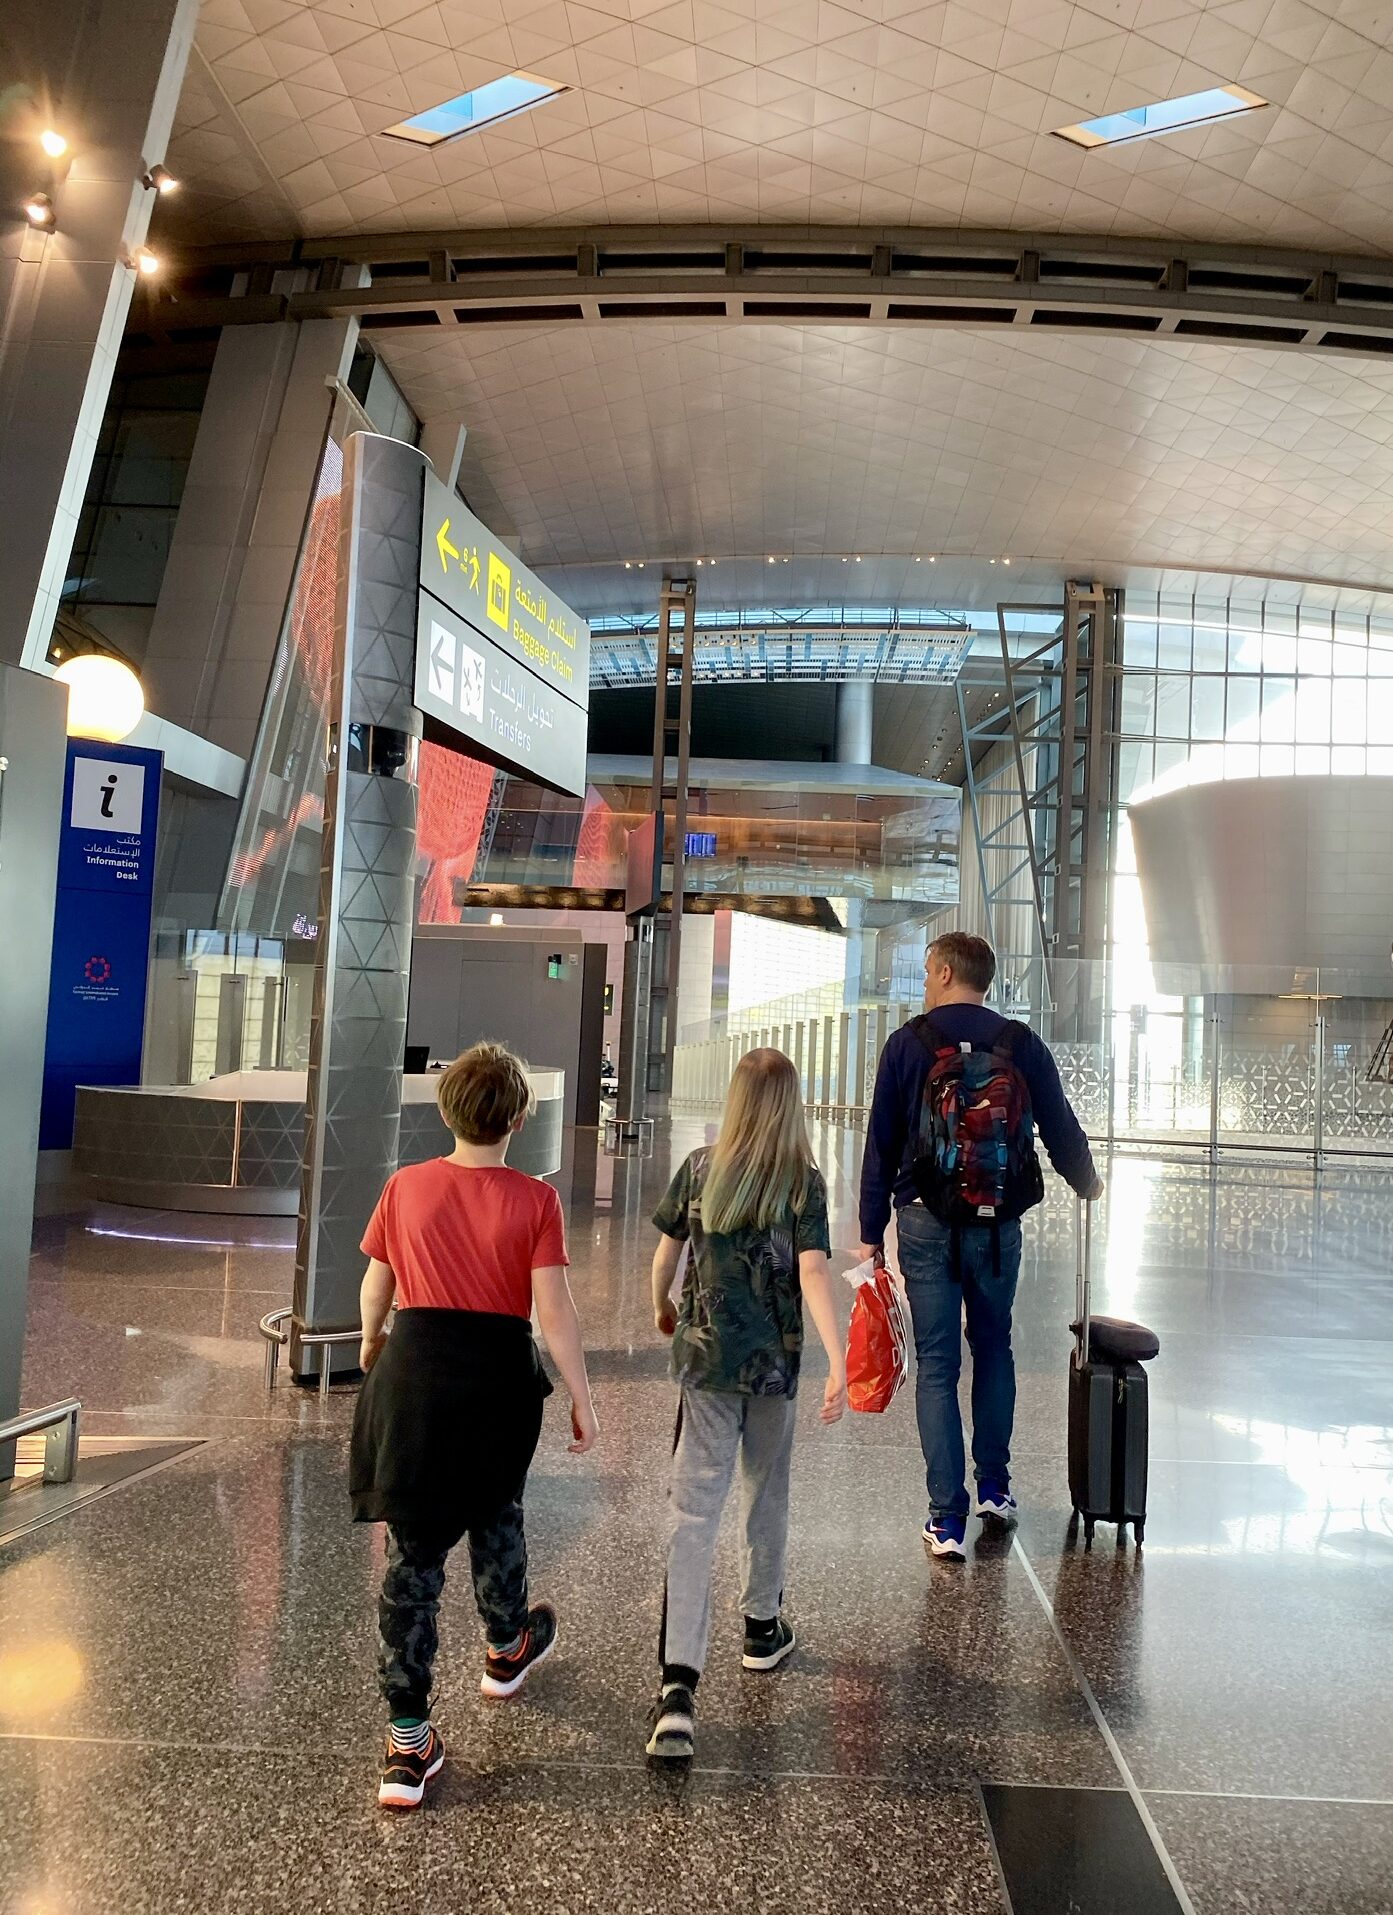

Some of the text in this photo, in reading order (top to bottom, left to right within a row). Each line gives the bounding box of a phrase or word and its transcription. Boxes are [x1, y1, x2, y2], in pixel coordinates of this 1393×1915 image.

[514, 578, 577, 651] استلام الأمتعة
[513, 619, 573, 682] Baggage Claim
[490, 669, 554, 729] تحويل الرحلات
[489, 708, 531, 752] Transfers
[86, 856, 139, 869] Information
[116, 836, 141, 846] مكتب
[116, 871, 138, 881] Desk
